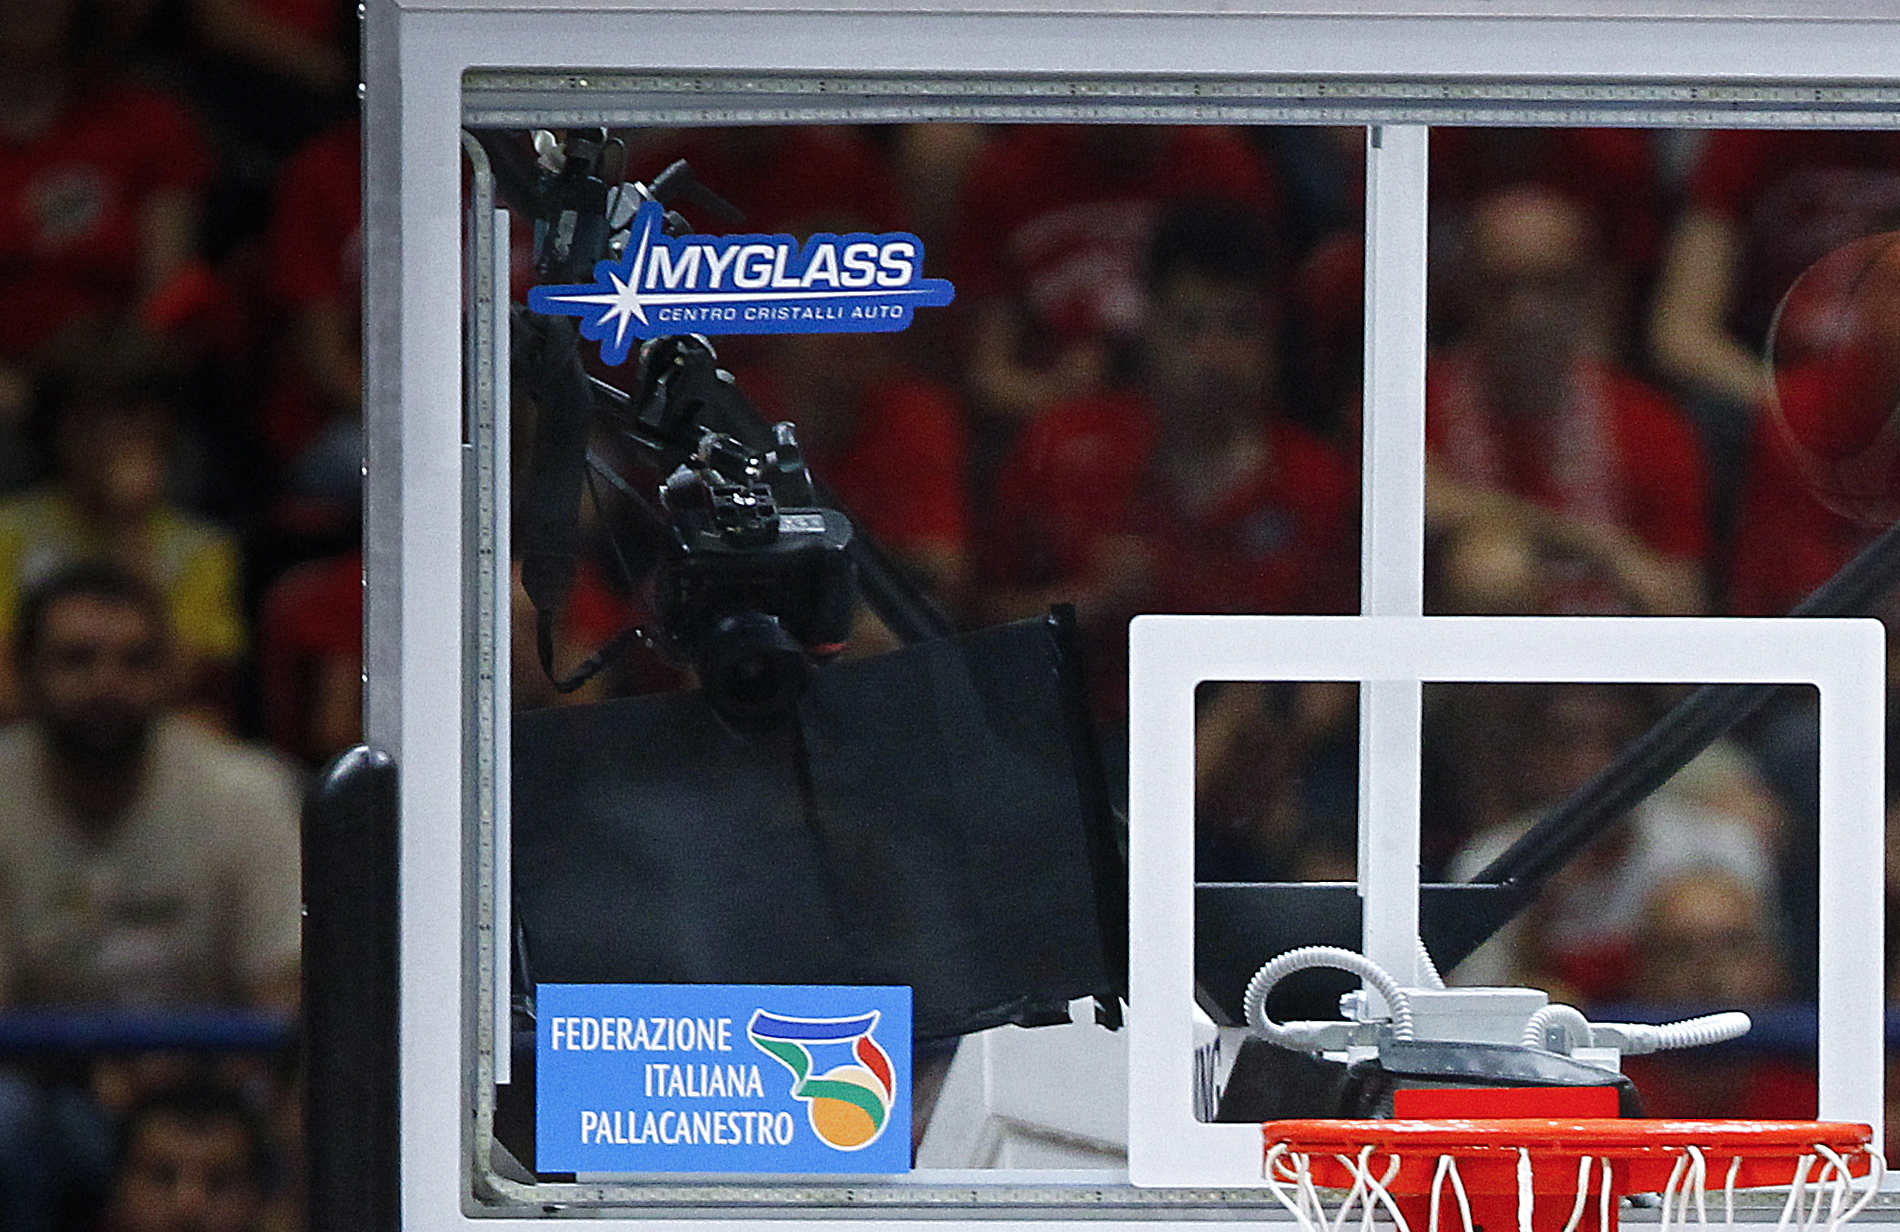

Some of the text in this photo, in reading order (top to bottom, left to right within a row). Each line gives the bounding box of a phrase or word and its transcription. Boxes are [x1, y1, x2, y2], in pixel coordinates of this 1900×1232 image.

[644, 242, 915, 290] MYGLASS
[658, 304, 903, 322] CENTRO CRISTALLI AUTO
[550, 1016, 732, 1052] FEDERAZIONE
[645, 1063, 765, 1098] ITALIANA
[580, 1110, 794, 1146] PALLACANESTRO
